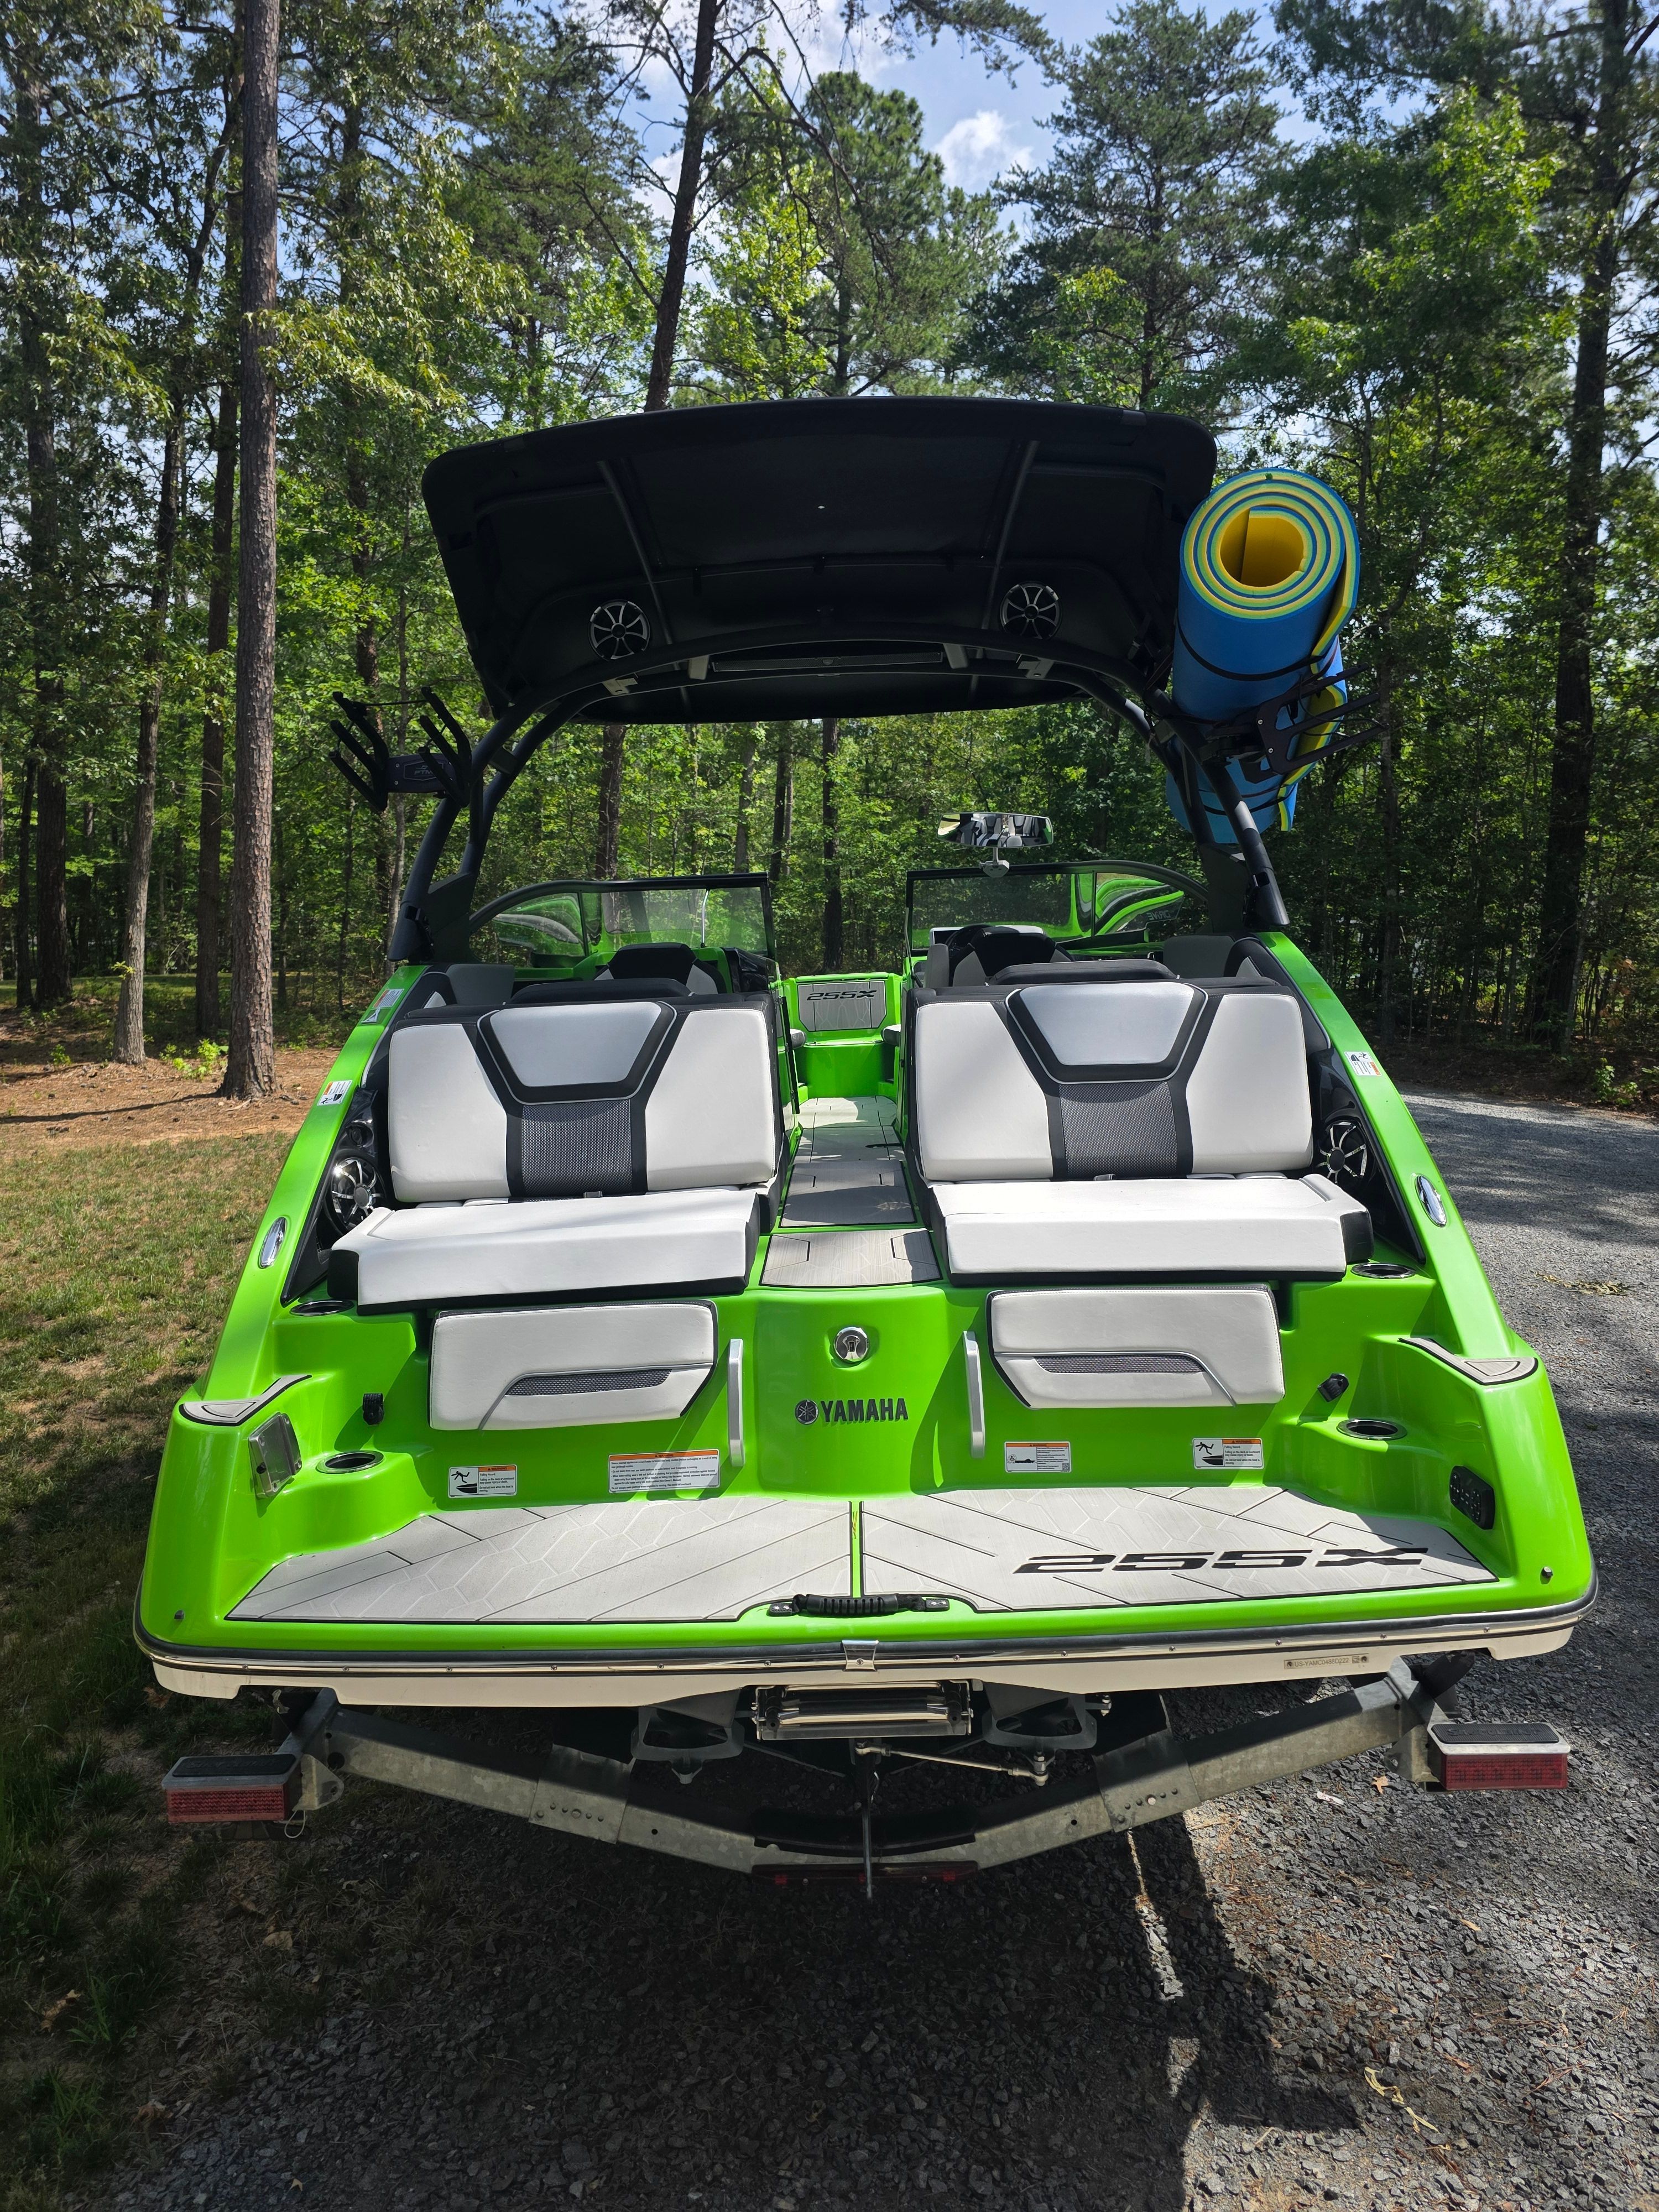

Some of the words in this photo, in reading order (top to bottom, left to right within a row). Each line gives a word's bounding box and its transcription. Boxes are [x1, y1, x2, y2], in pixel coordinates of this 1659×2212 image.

[807, 990, 877, 1000] 255X
[820, 1398, 909, 1422] YAMAHA
[1013, 1547, 1429, 1574] 255X
